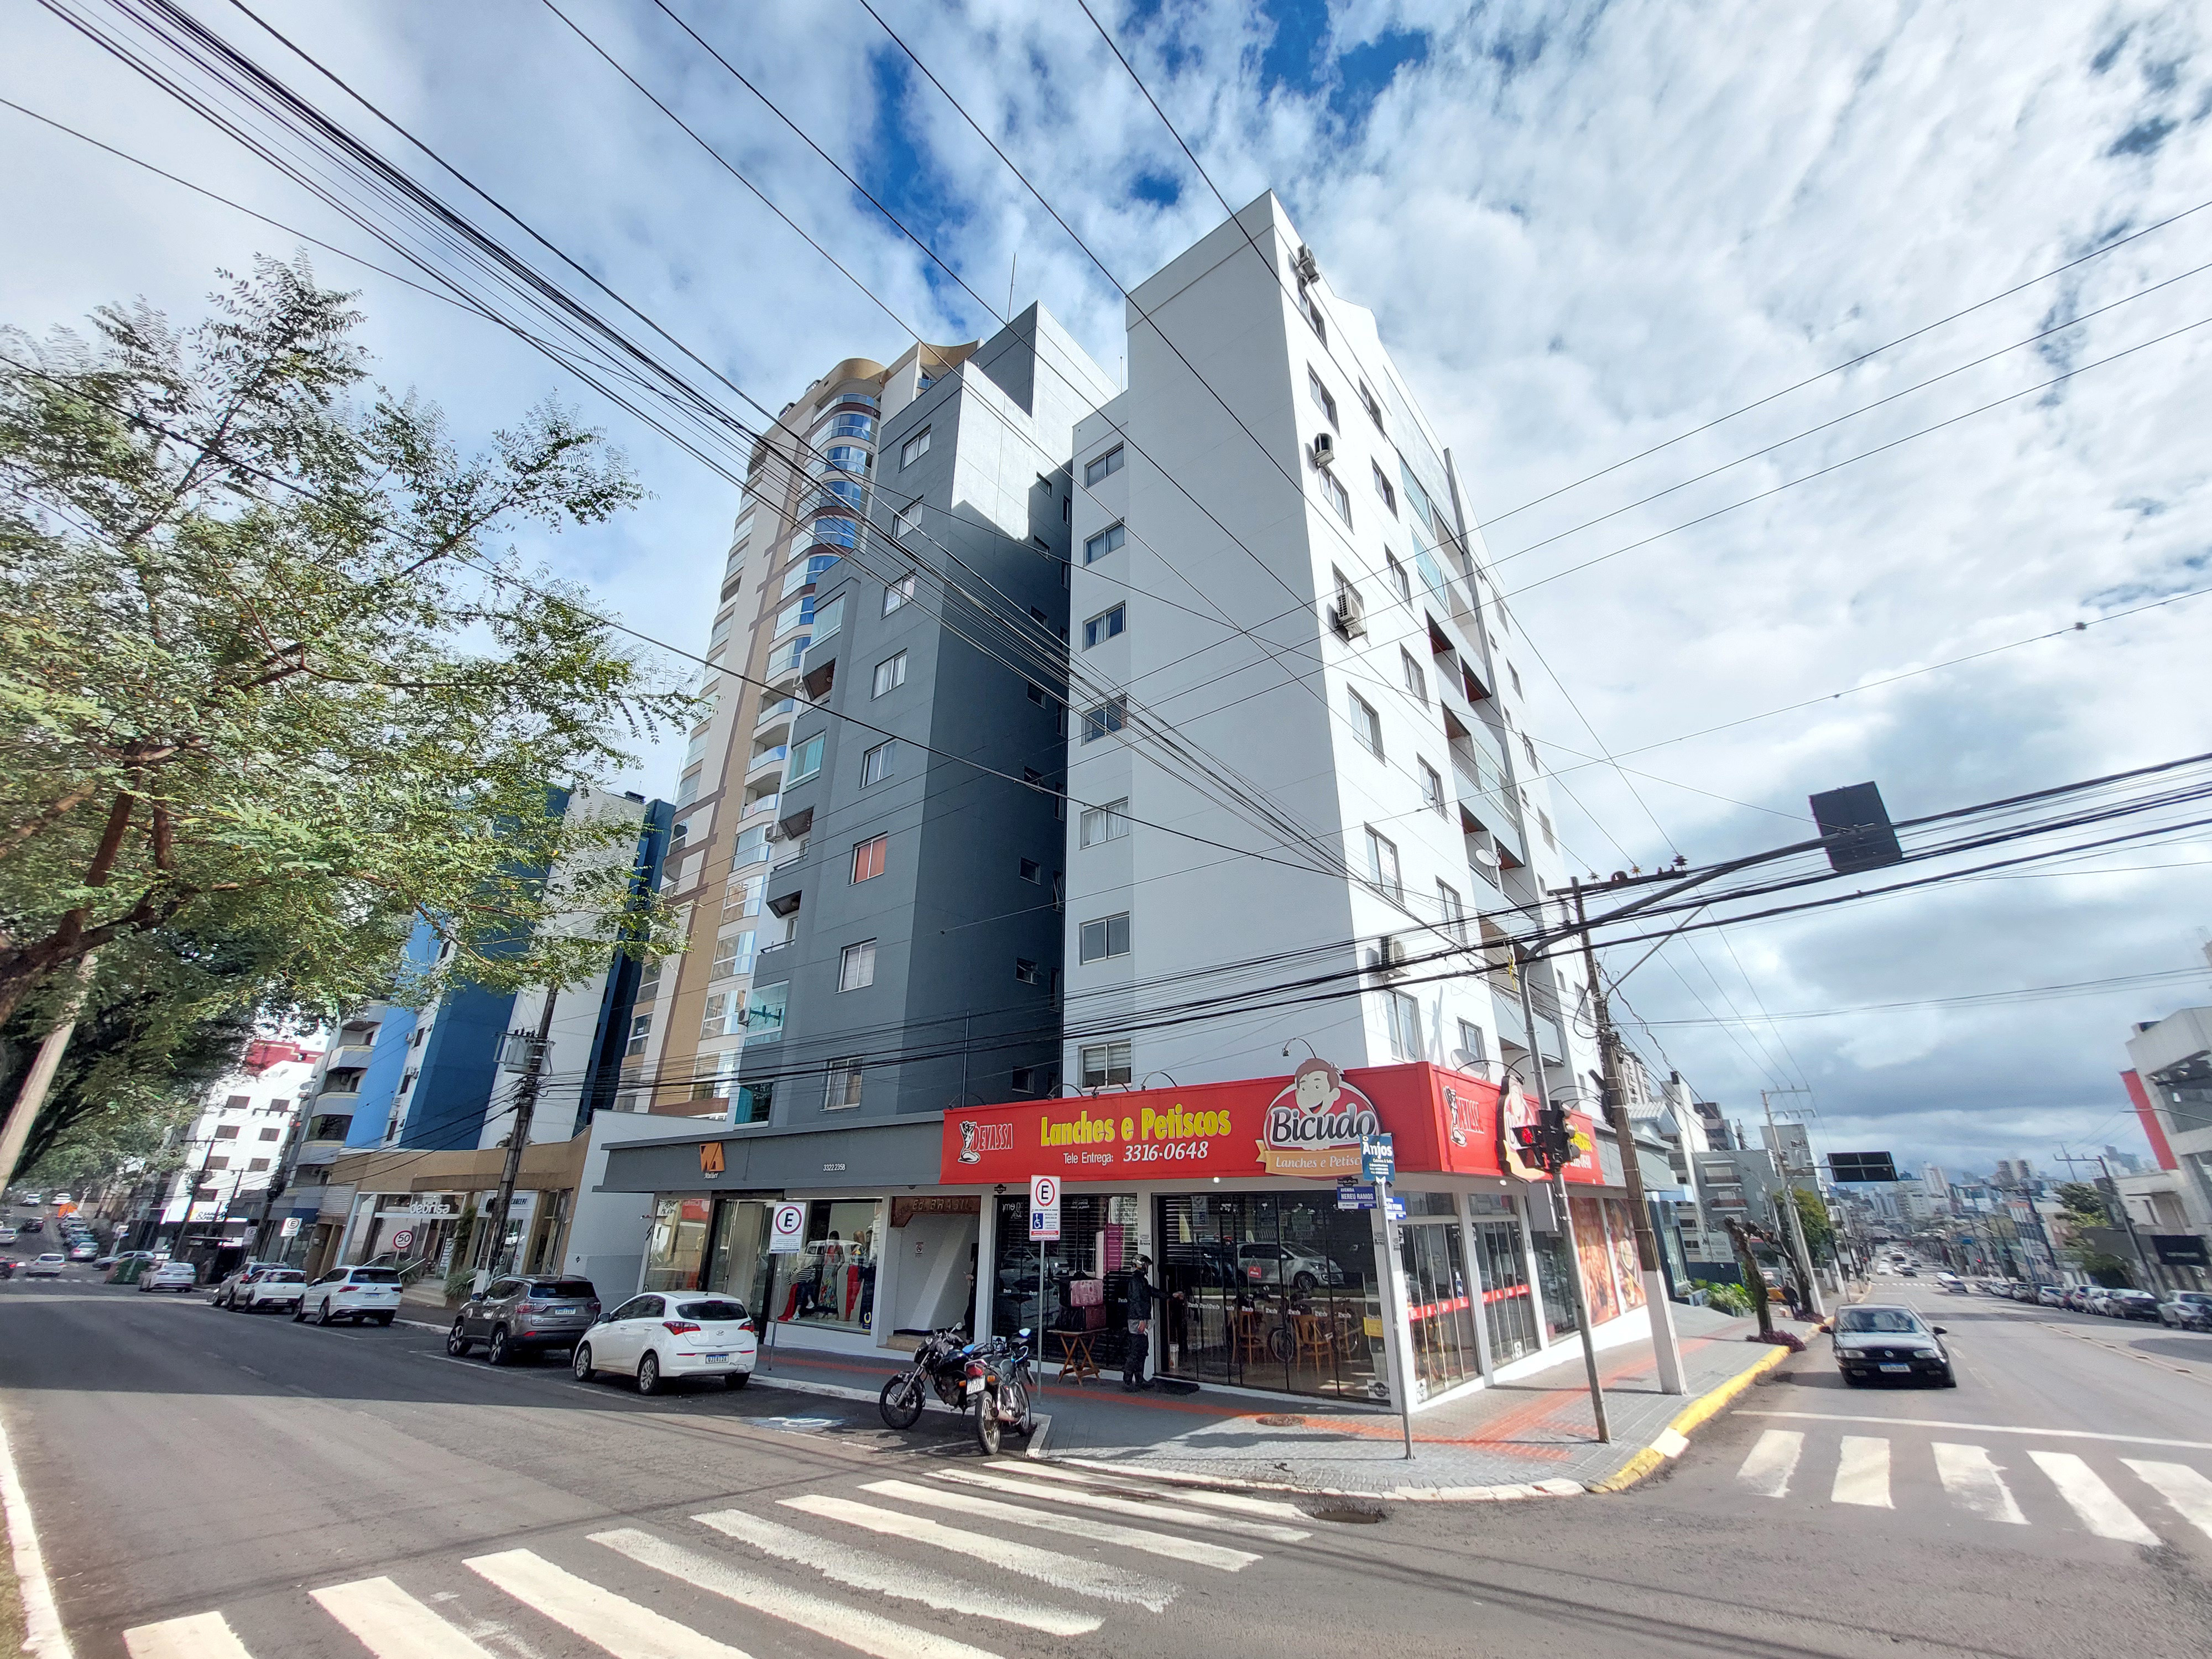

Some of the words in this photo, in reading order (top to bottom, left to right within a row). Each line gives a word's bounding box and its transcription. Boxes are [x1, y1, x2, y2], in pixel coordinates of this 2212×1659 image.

[1041, 1110, 1115, 1146] Lanches
[1121, 1117, 1134, 1141] e
[1141, 1104, 1231, 1141] Petiscos
[1272, 1105, 1375, 1142] Bicudo
[973, 1123, 1013, 1151] DEVASSA
[1362, 1139, 1392, 1159] Anjos
[1063, 1152, 1078, 1164] Tele
[1082, 1152, 1113, 1166] Entrega:
[1276, 1157, 1317, 1168] Lanches
[1321, 1159, 1326, 1167] e
[1330, 1155, 1363, 1167] Petisc
[1041, 1185, 1048, 1199] E
[410, 1201, 451, 1214] debrisa
[784, 1213, 794, 1227] E
